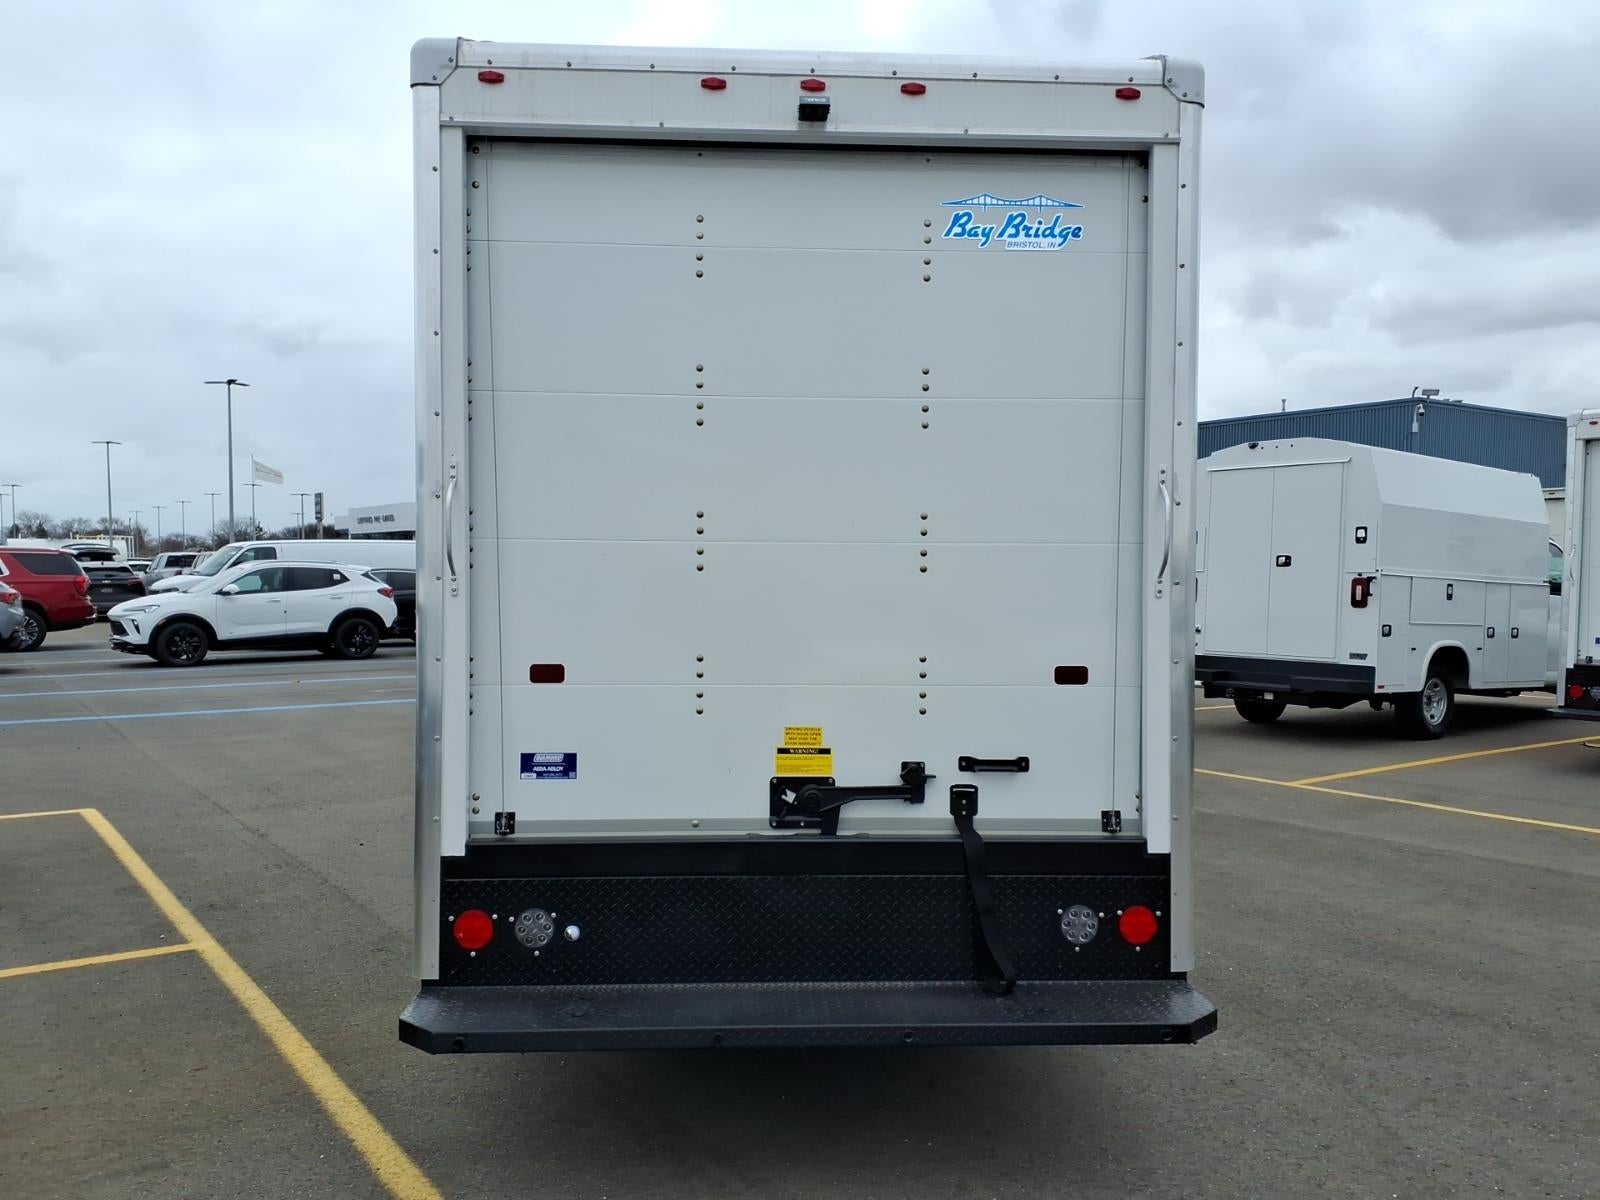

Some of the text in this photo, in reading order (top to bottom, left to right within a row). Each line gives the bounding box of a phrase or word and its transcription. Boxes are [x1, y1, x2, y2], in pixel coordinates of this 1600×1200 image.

[943, 211, 1082, 248] Bay Bridge
[1007, 241, 1046, 249] BRISTOL,
